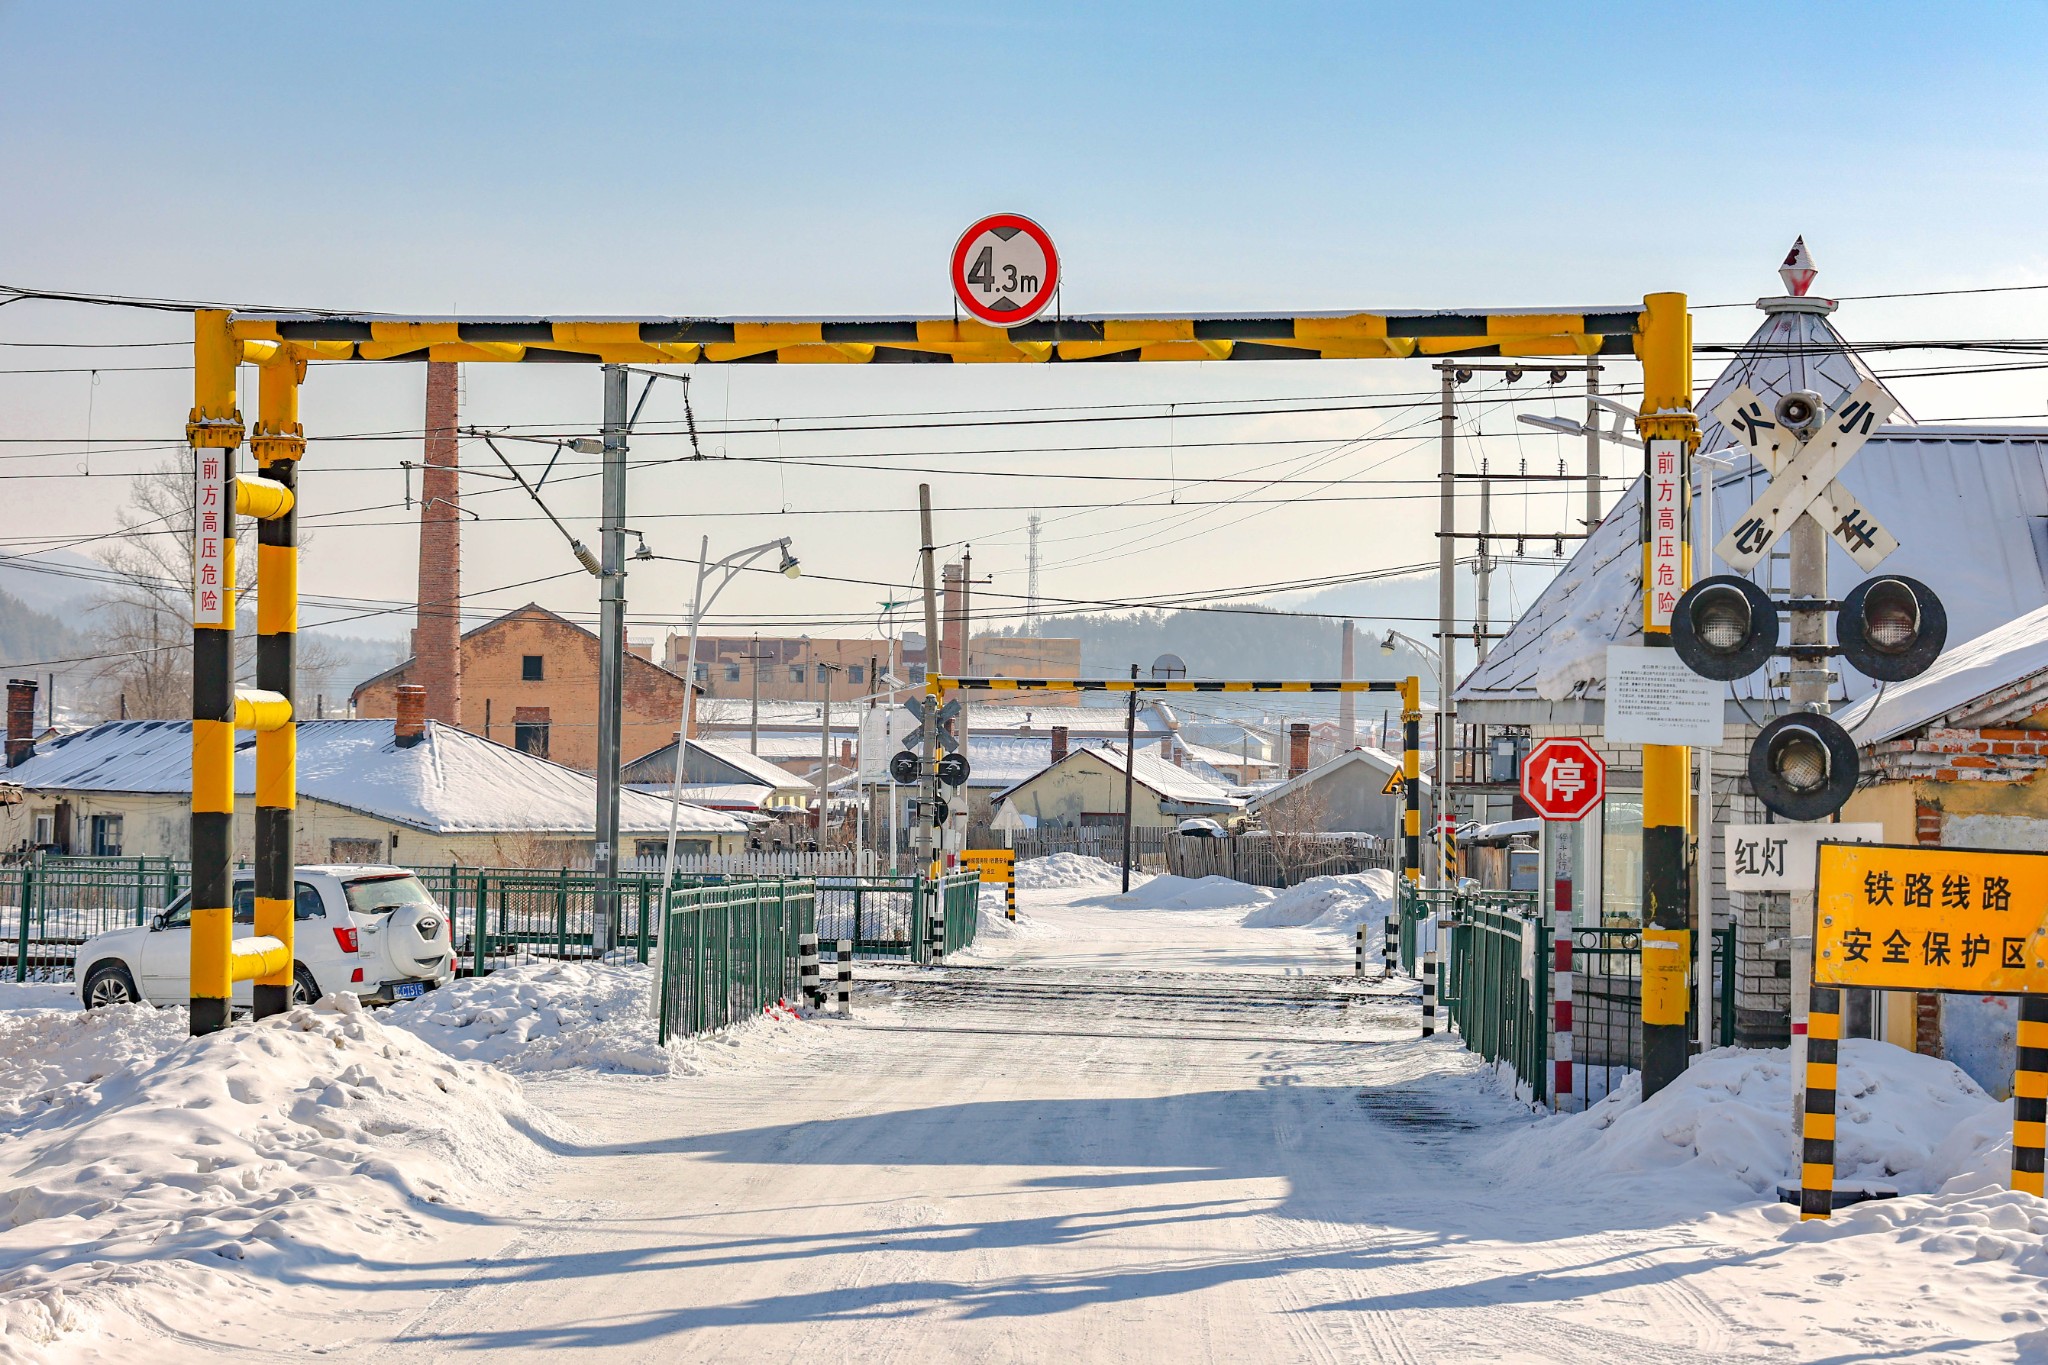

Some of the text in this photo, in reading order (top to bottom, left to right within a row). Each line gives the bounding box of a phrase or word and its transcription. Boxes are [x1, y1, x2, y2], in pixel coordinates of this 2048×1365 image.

[967, 246, 1038, 293] 4.3m
[201, 457, 219, 612] 前方高压危险
[1657, 451, 1675, 613] 前方高压危险
[1540, 757, 1585, 802] 停
[1735, 837, 1788, 877] 红灯
[1864, 870, 2012, 912] 铁路线路
[1842, 927, 2027, 969] 安全保护区
